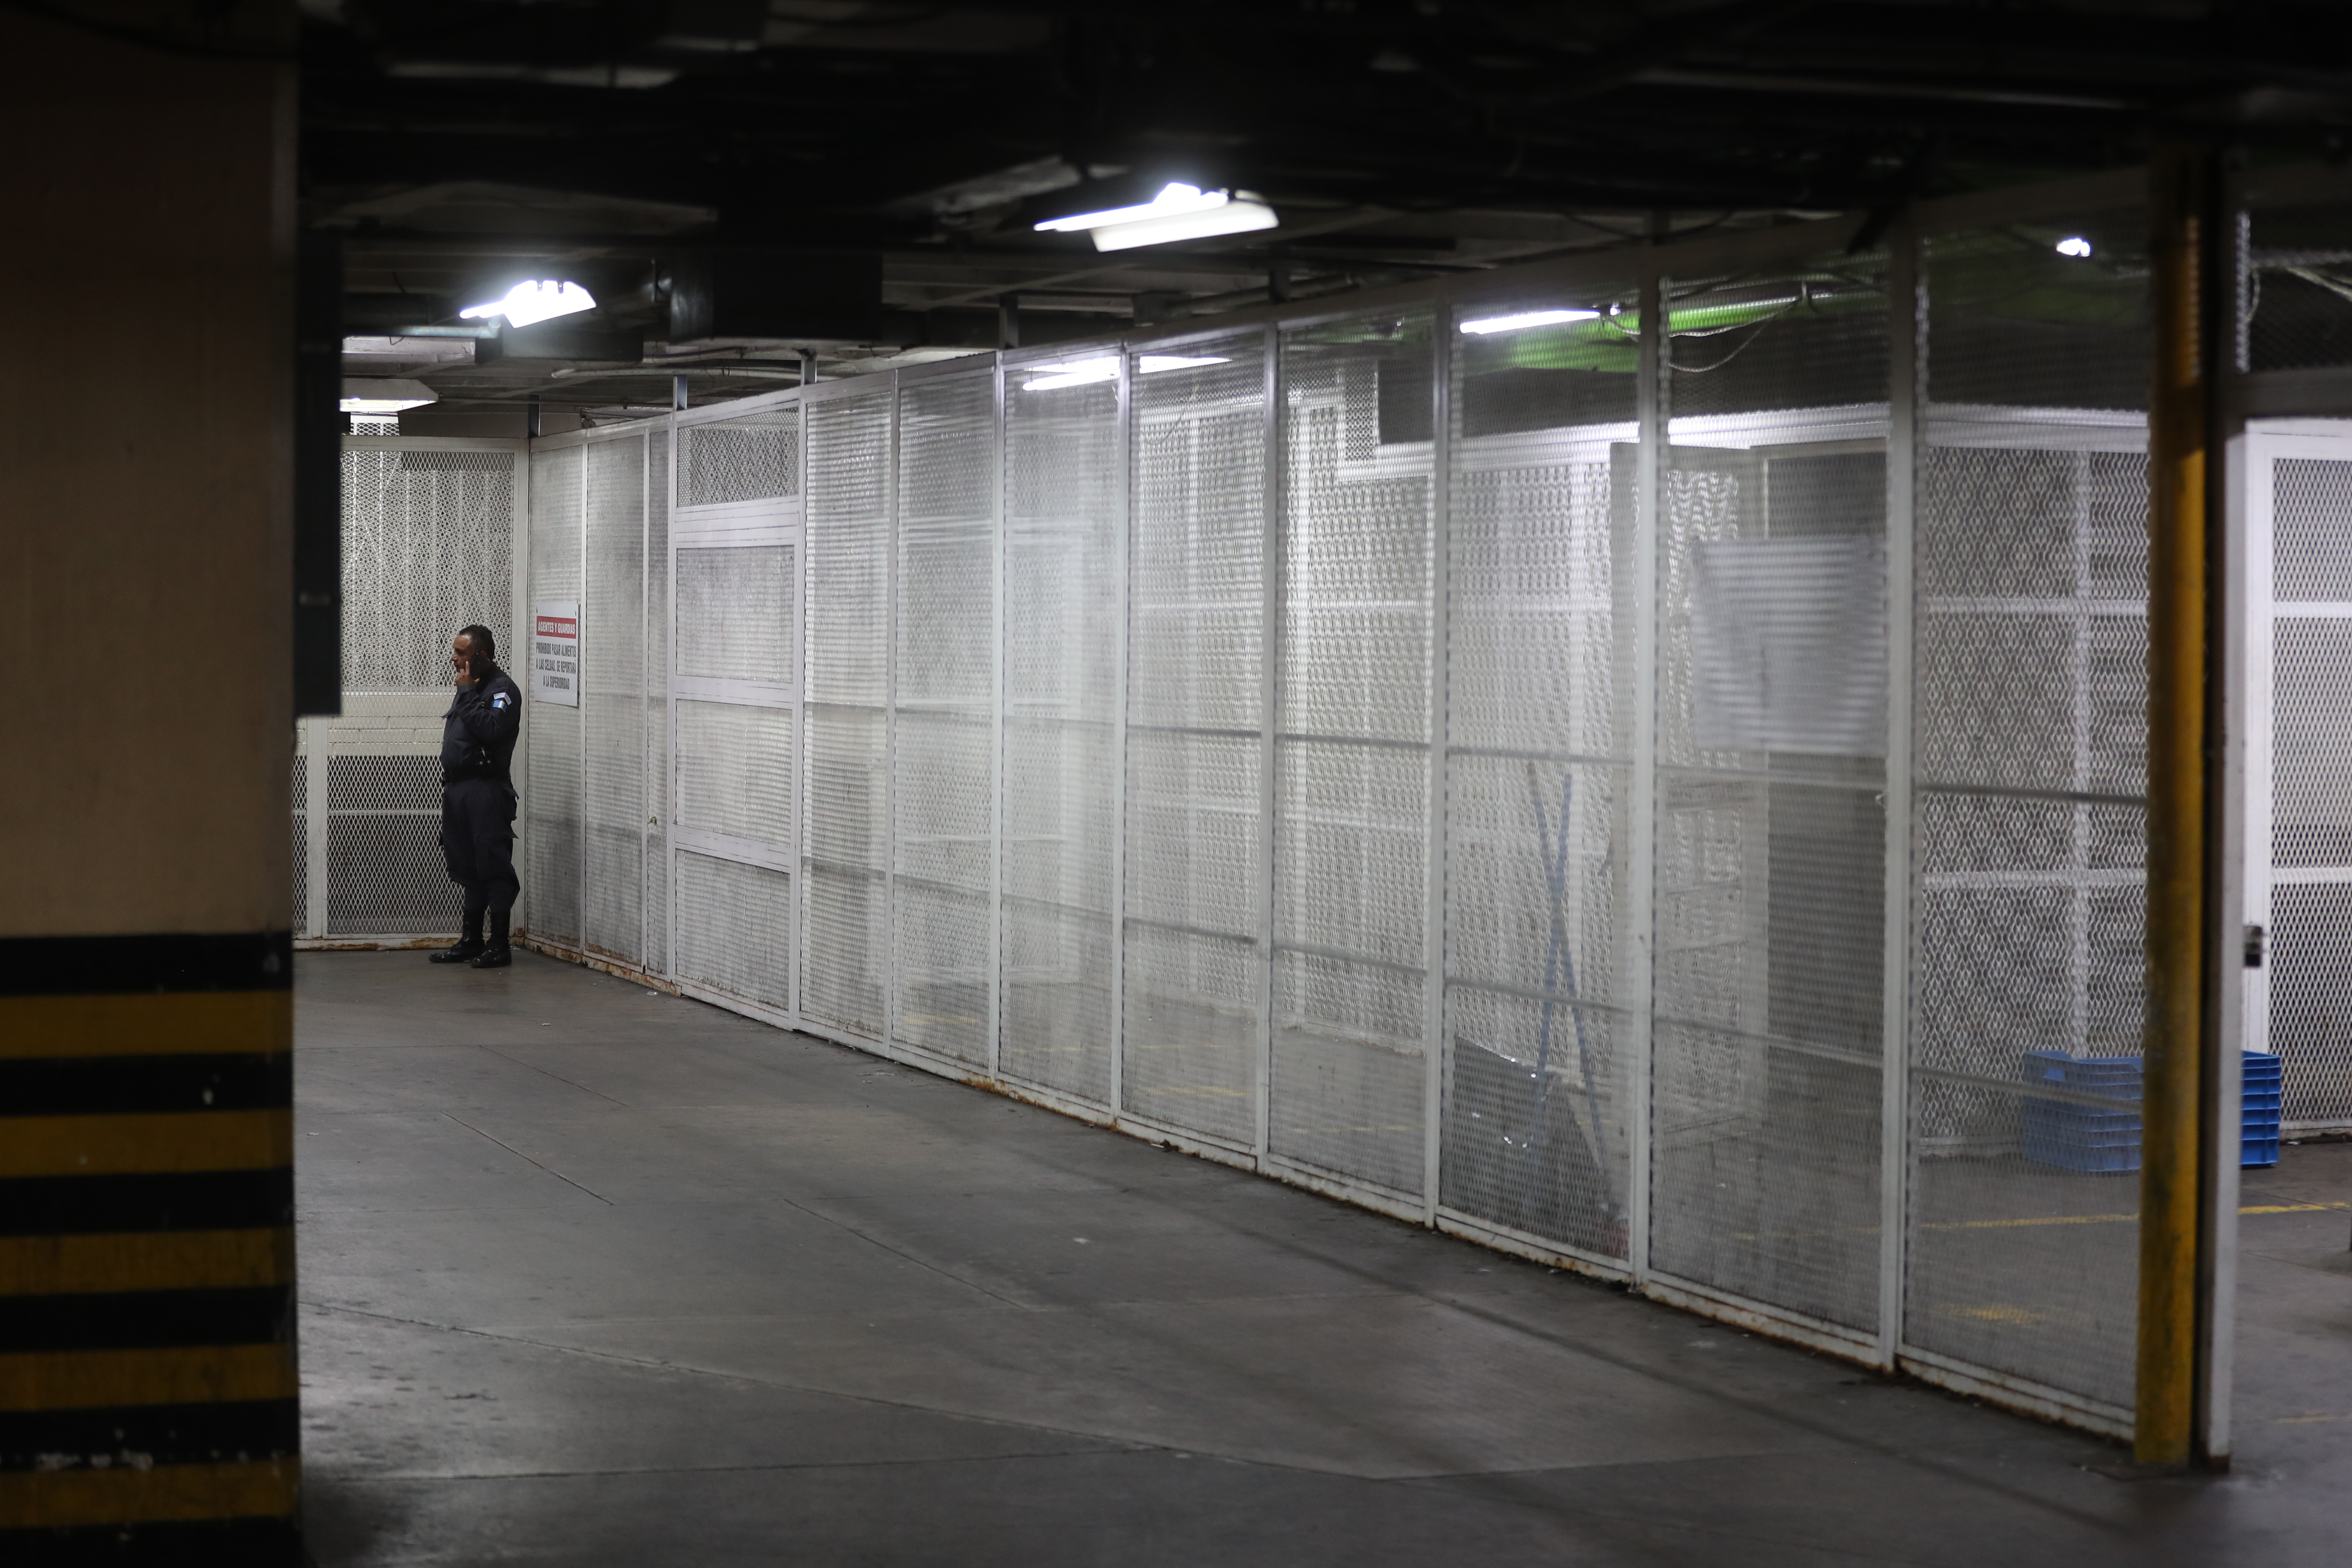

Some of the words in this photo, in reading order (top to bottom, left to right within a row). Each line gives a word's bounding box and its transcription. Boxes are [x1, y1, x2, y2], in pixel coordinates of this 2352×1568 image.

[538, 621, 554, 633] AGENTES
[554, 622, 557, 633] Y
[557, 622, 575, 635] GUARDIAS
[551, 643, 560, 656] PASAR
[561, 644, 576, 658] ALIMENTOS
[536, 658, 538, 669] A
[557, 660, 560, 672] SE
[543, 675, 545, 686] A
[545, 675, 549, 687] LA
